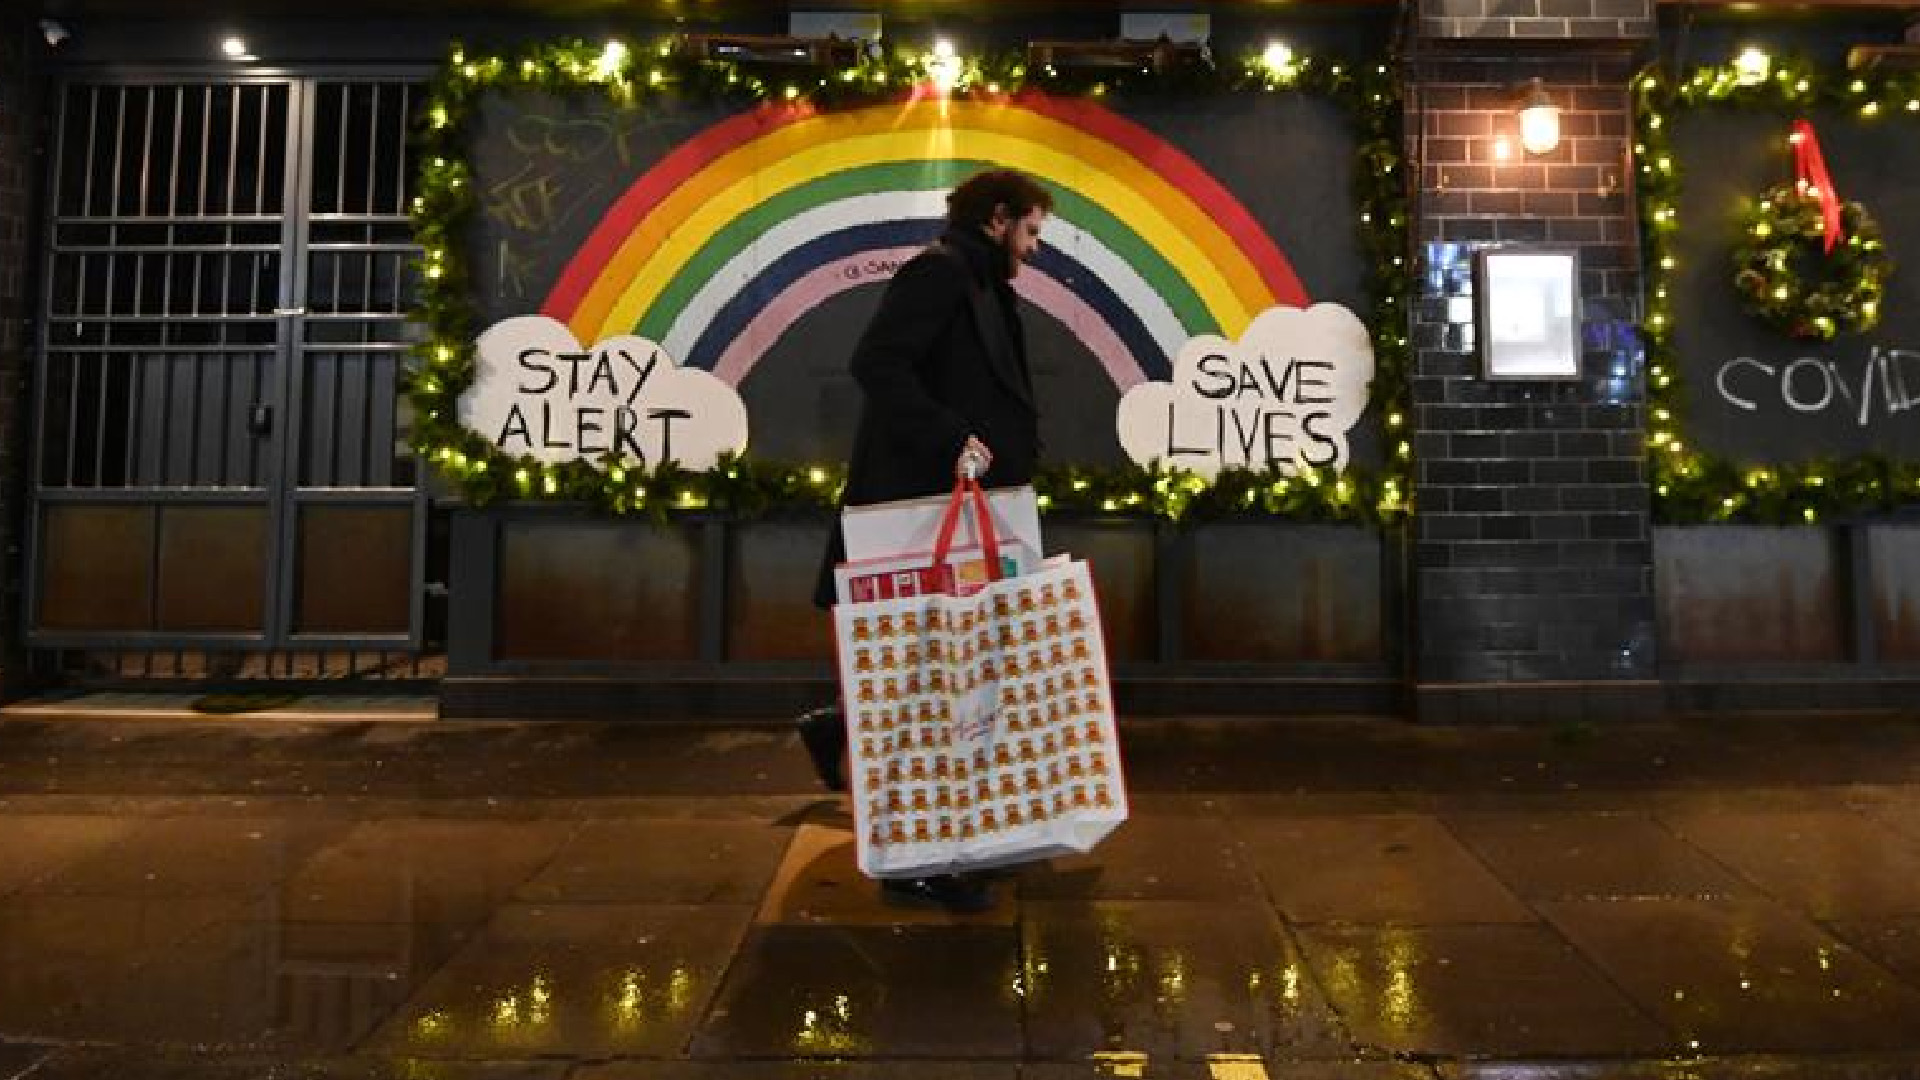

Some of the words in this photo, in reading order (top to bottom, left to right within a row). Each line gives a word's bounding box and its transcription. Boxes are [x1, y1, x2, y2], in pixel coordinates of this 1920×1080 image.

[518, 349, 658, 404] STAY
[1192, 354, 1337, 404] SAVE
[497, 400, 693, 465] ALERT
[1167, 402, 1339, 468] LIVES
